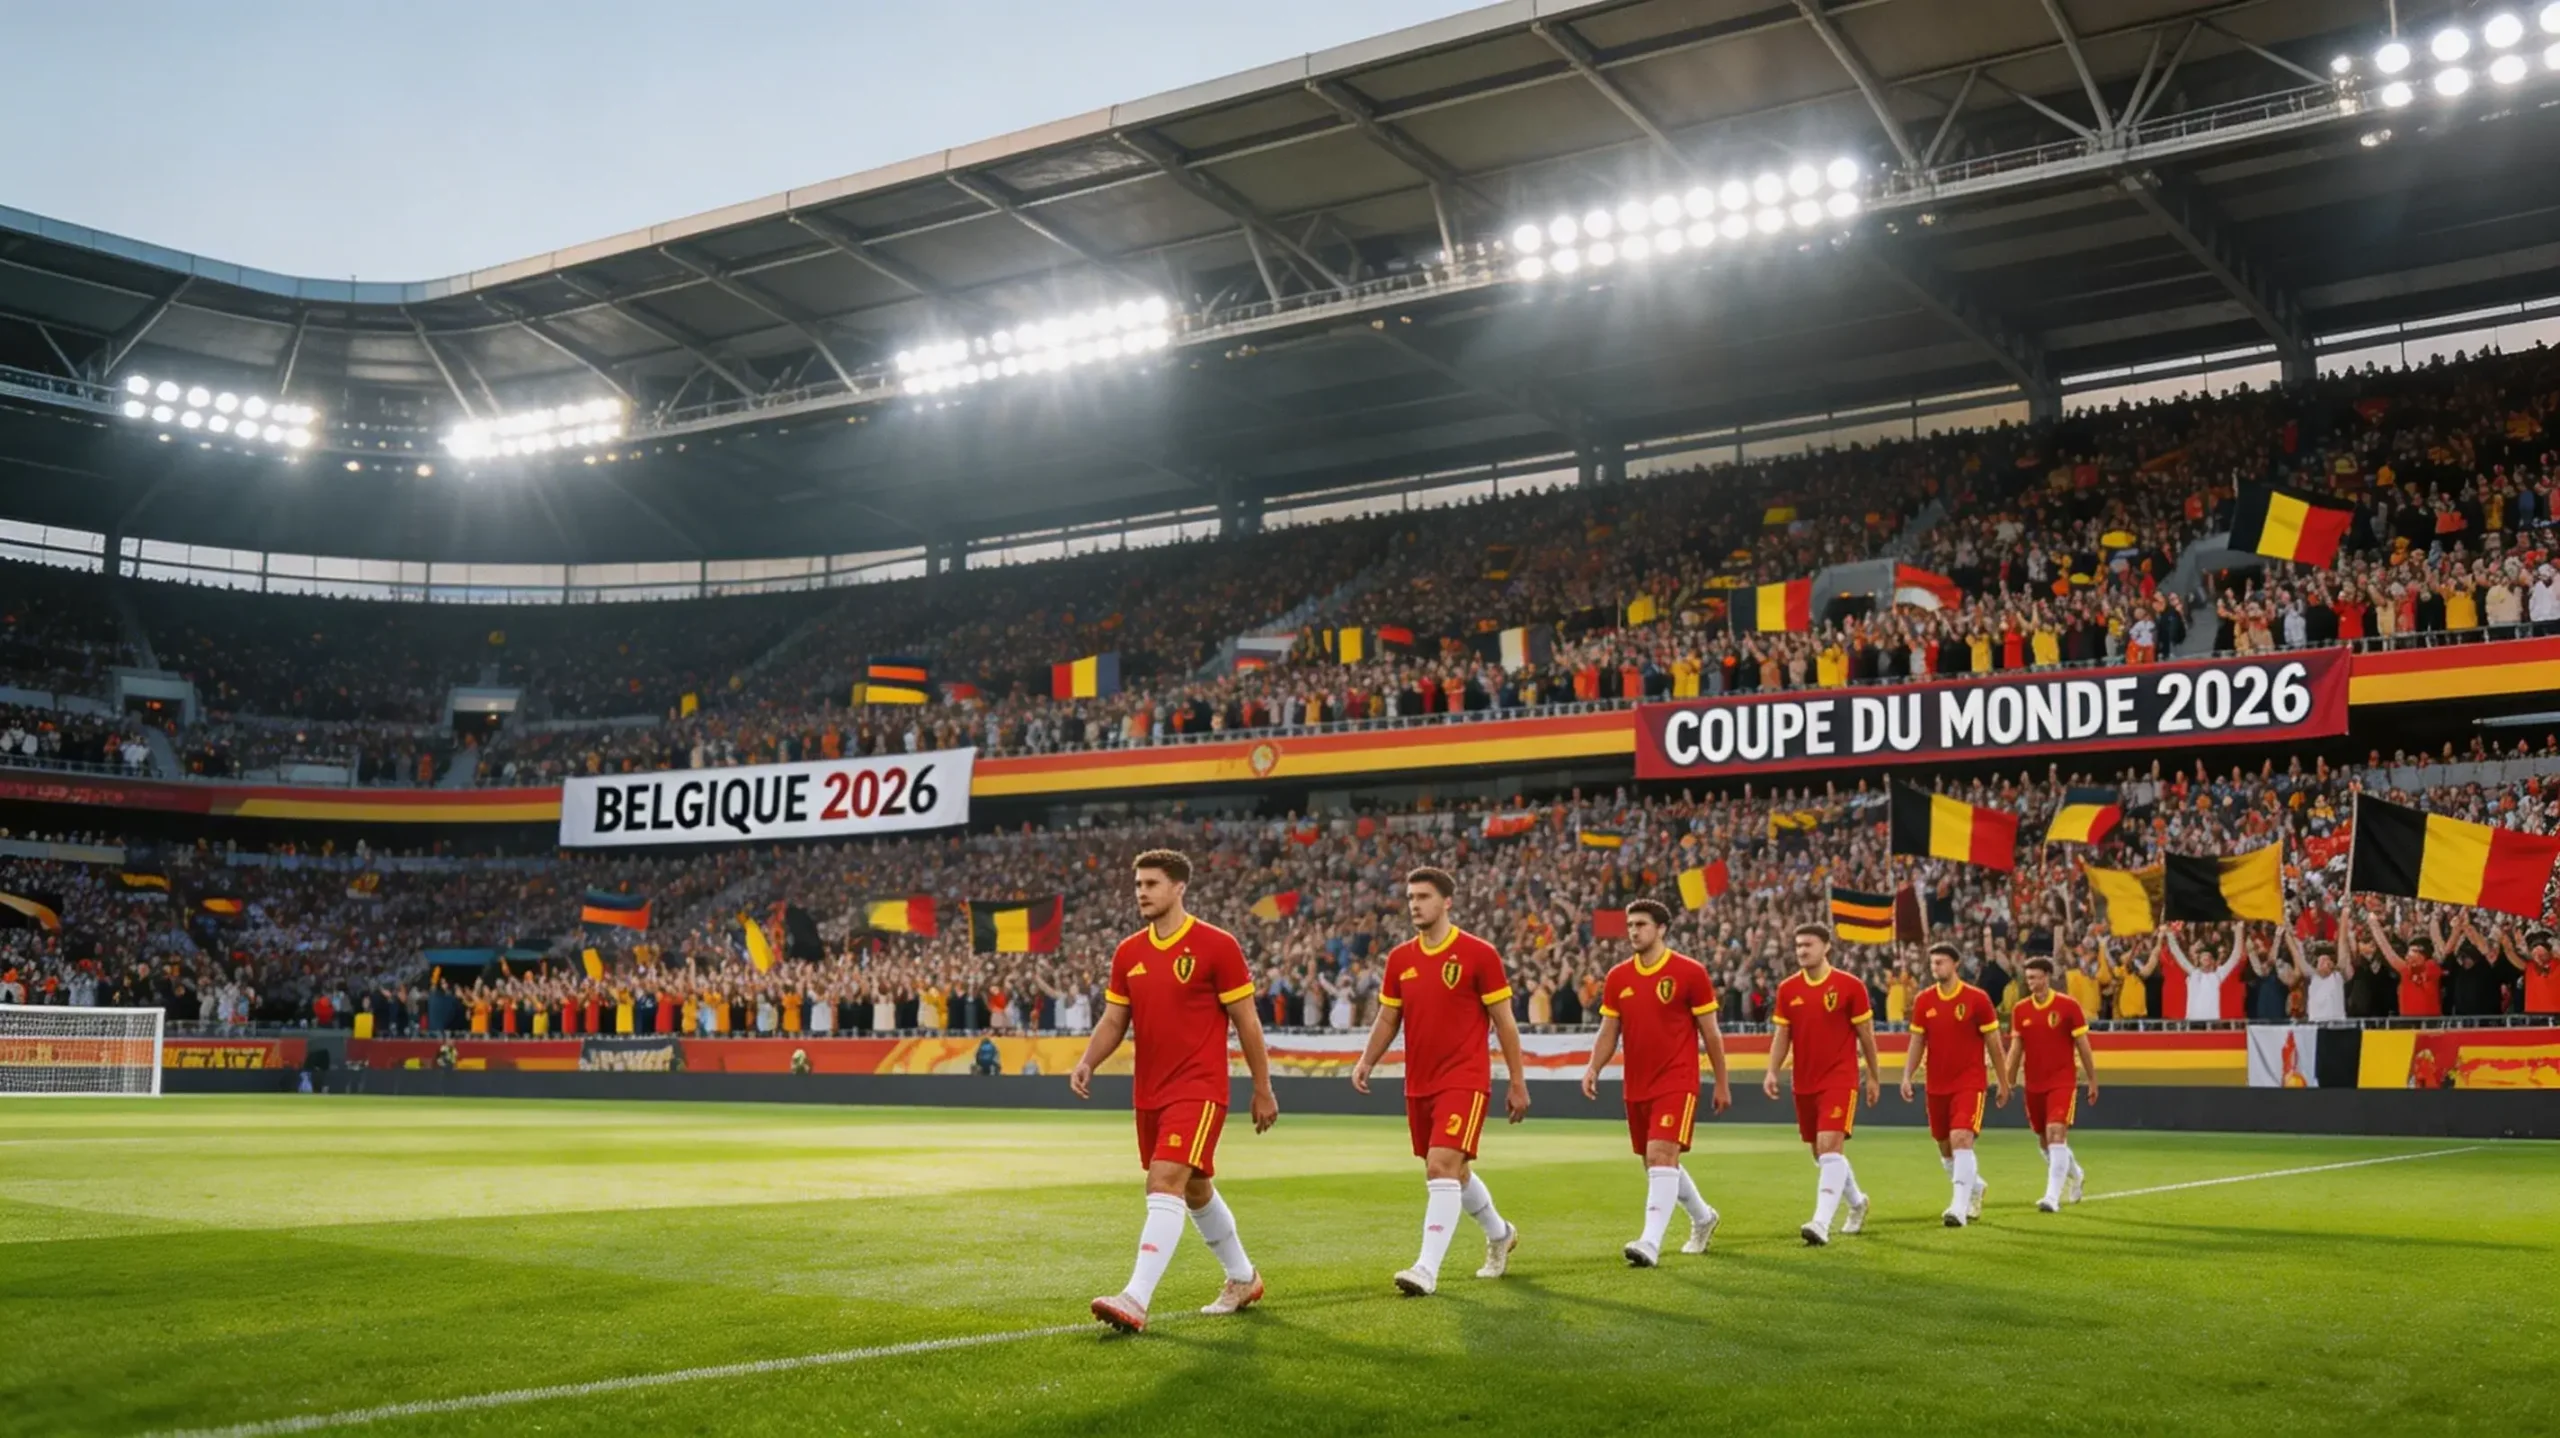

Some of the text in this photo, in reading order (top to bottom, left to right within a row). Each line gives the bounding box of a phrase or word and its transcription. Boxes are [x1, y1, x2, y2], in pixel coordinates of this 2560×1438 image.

[1664, 662, 2311, 766] COUPE DU MONDE 2026
[593, 764, 939, 835] BELGIQUE 2026
